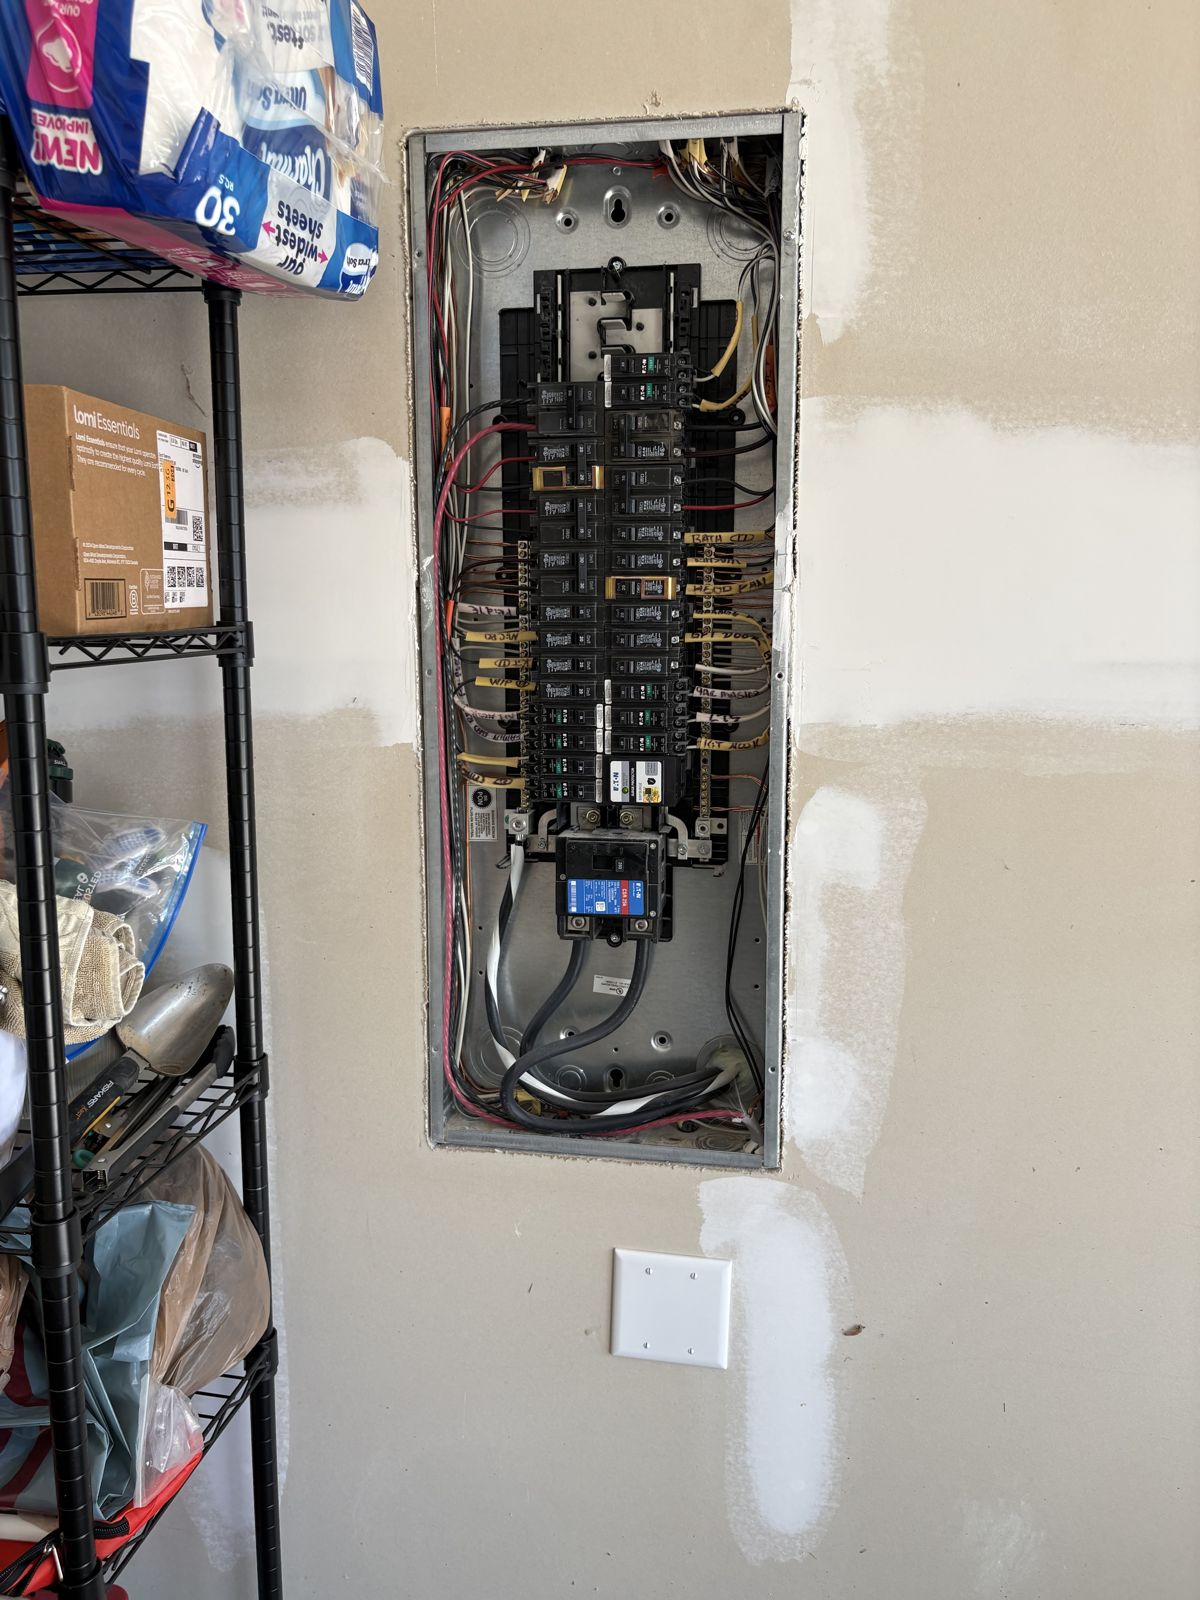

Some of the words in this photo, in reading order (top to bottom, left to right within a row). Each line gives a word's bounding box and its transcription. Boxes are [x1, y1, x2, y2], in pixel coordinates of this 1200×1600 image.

[33, 129, 101, 172] NEW!
[195, 186, 241, 236] 30
[277, 200, 324, 240] sheets
[275, 224, 318, 262] widest
[276, 255, 305, 276] our
[97, 412, 140, 440] Essentials
[86, 1080, 115, 1109] FISKARS
